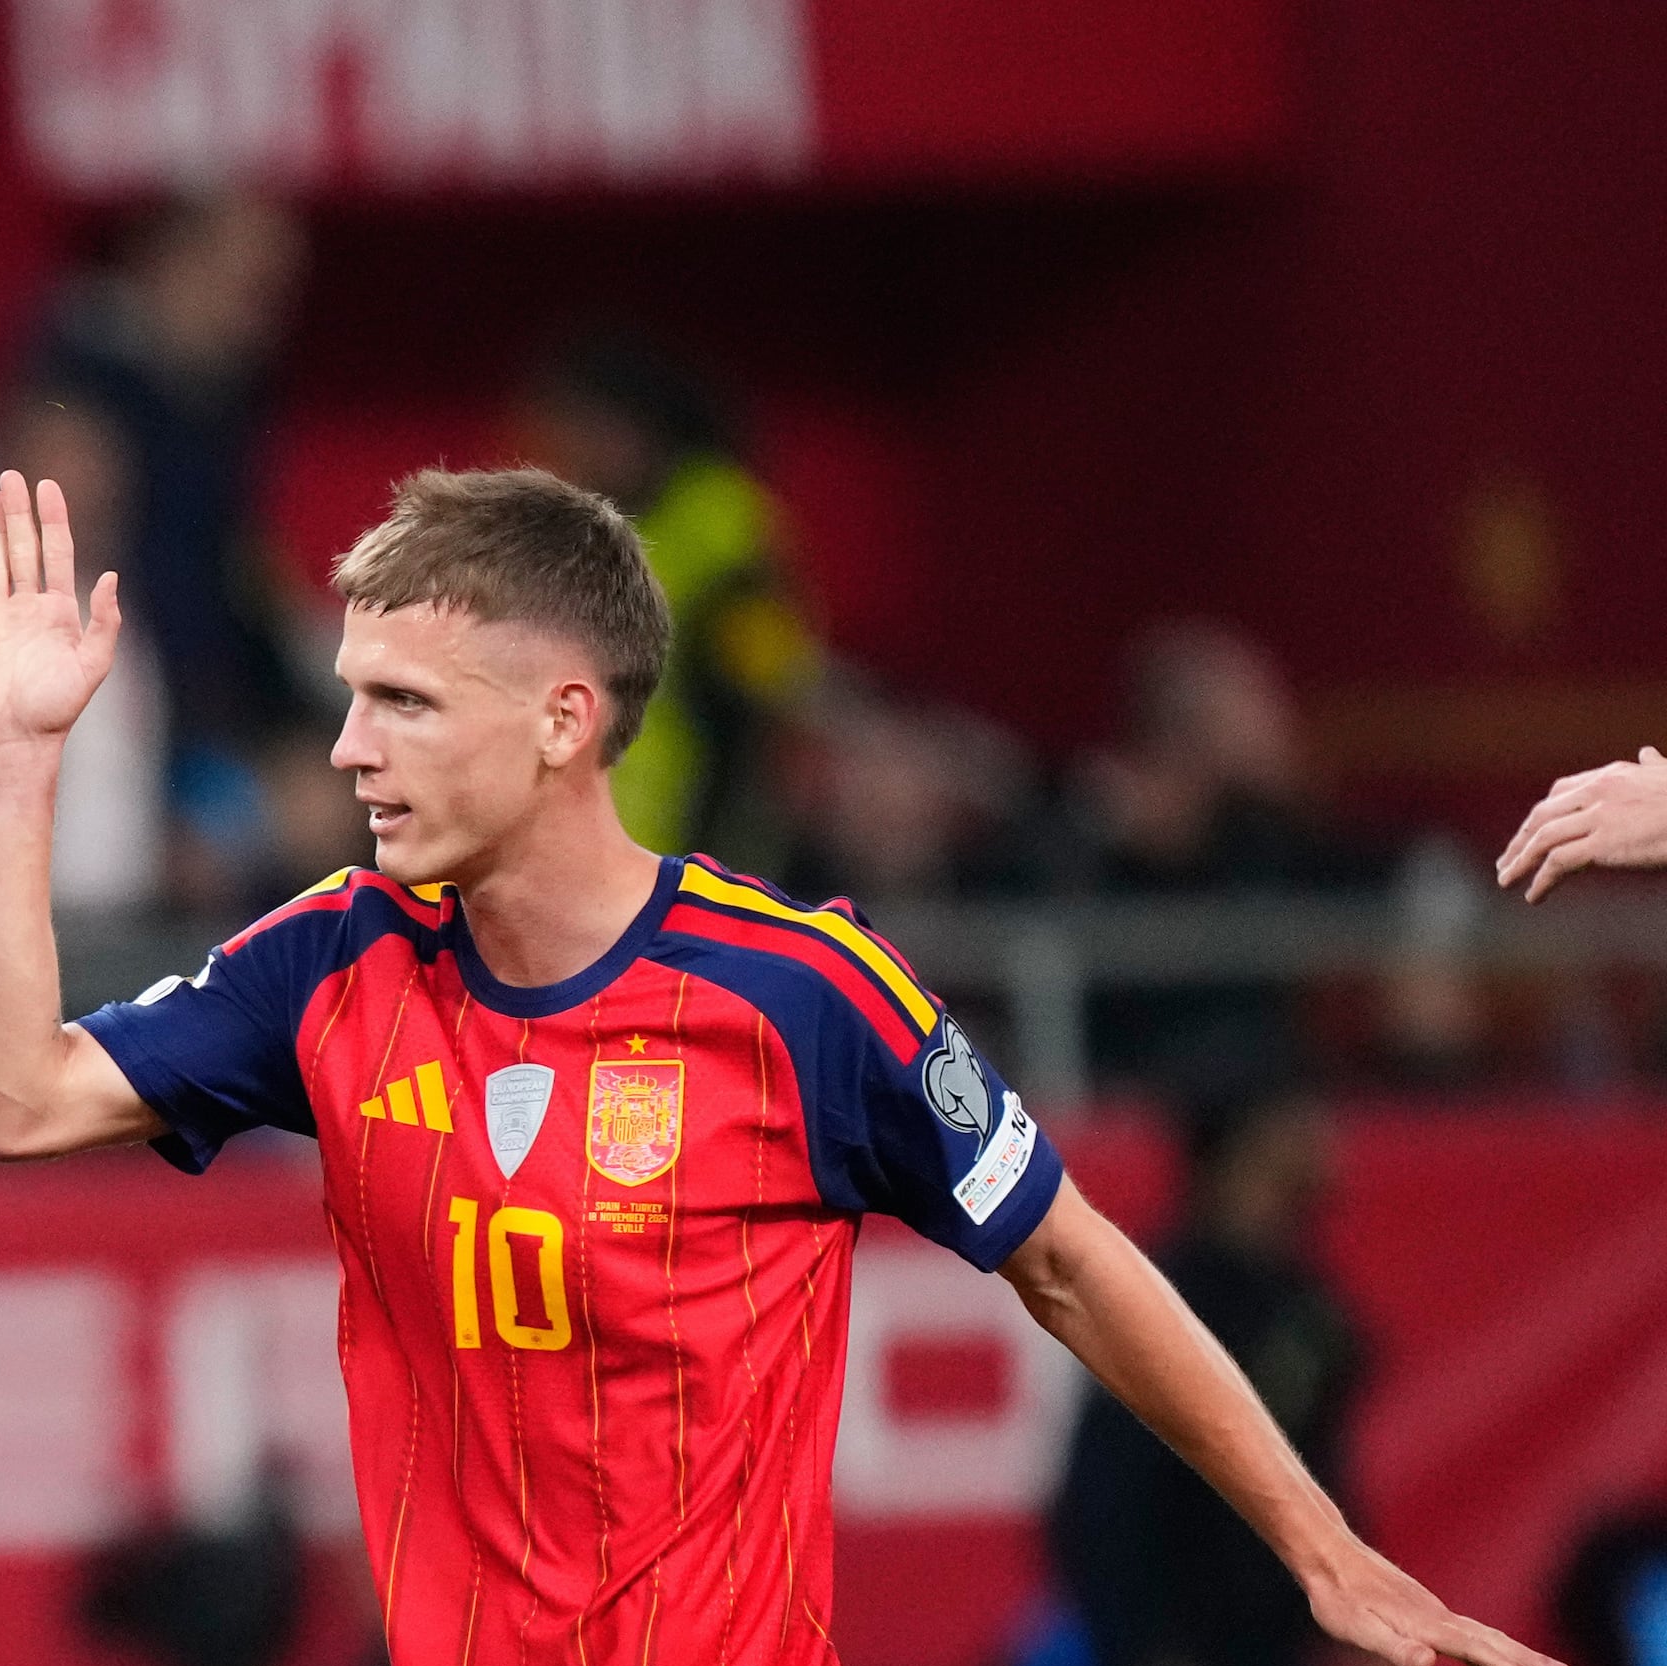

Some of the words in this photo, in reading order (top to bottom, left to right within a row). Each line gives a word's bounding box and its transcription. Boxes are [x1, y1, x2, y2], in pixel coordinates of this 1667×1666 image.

[966, 1137, 1020, 1210] FOUNDATION
[595, 1201, 621, 1212] SPAIN
[630, 1203, 663, 1213] TURKEY
[600, 1213, 646, 1223] NOVEMBER
[648, 1214, 669, 1223] 2025
[612, 1223, 645, 1234] SEVILLE
[448, 1196, 572, 1352] 10
